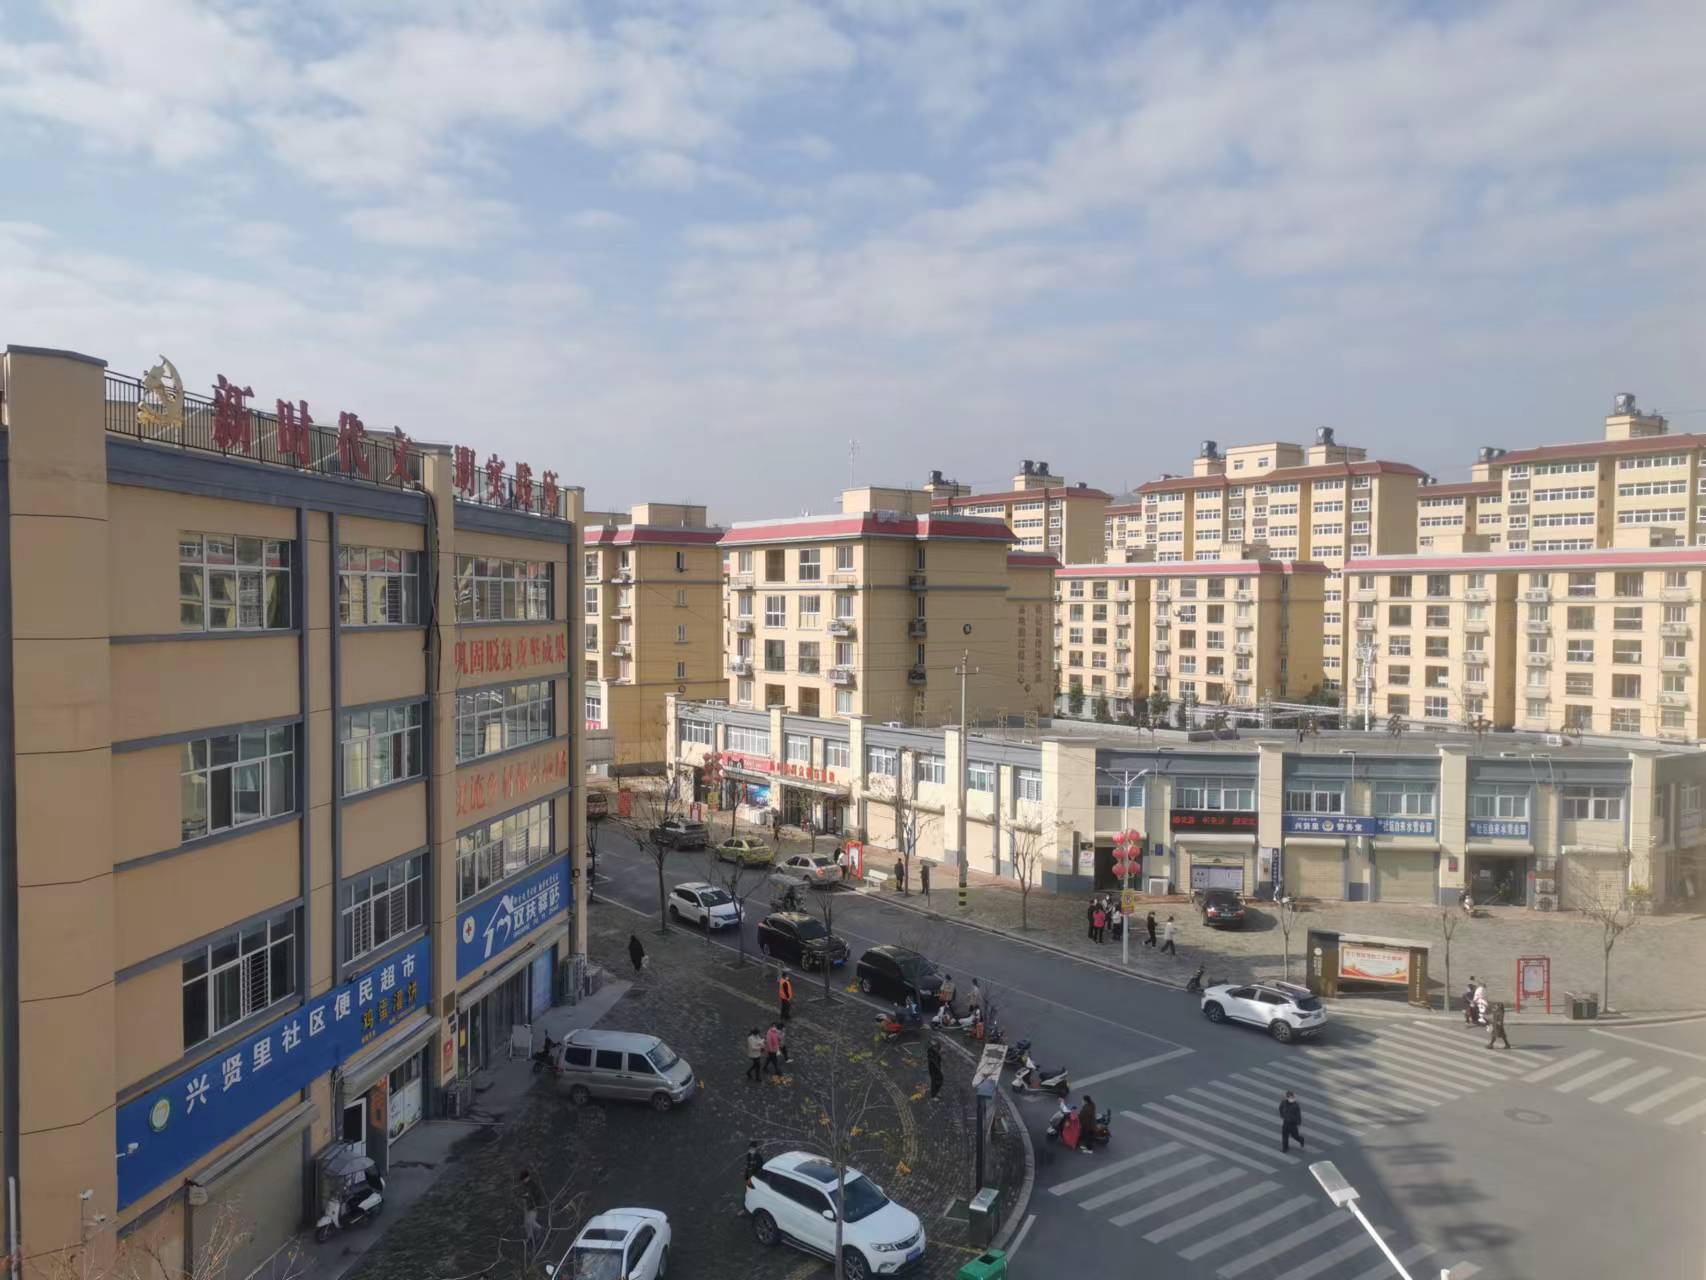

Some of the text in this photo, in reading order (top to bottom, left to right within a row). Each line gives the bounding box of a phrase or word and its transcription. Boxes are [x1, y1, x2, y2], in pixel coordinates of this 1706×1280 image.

[454, 634, 567, 674] 巩固脱贫攻坚成果
[185, 952, 417, 1114] 兴贤里社区便民超市
